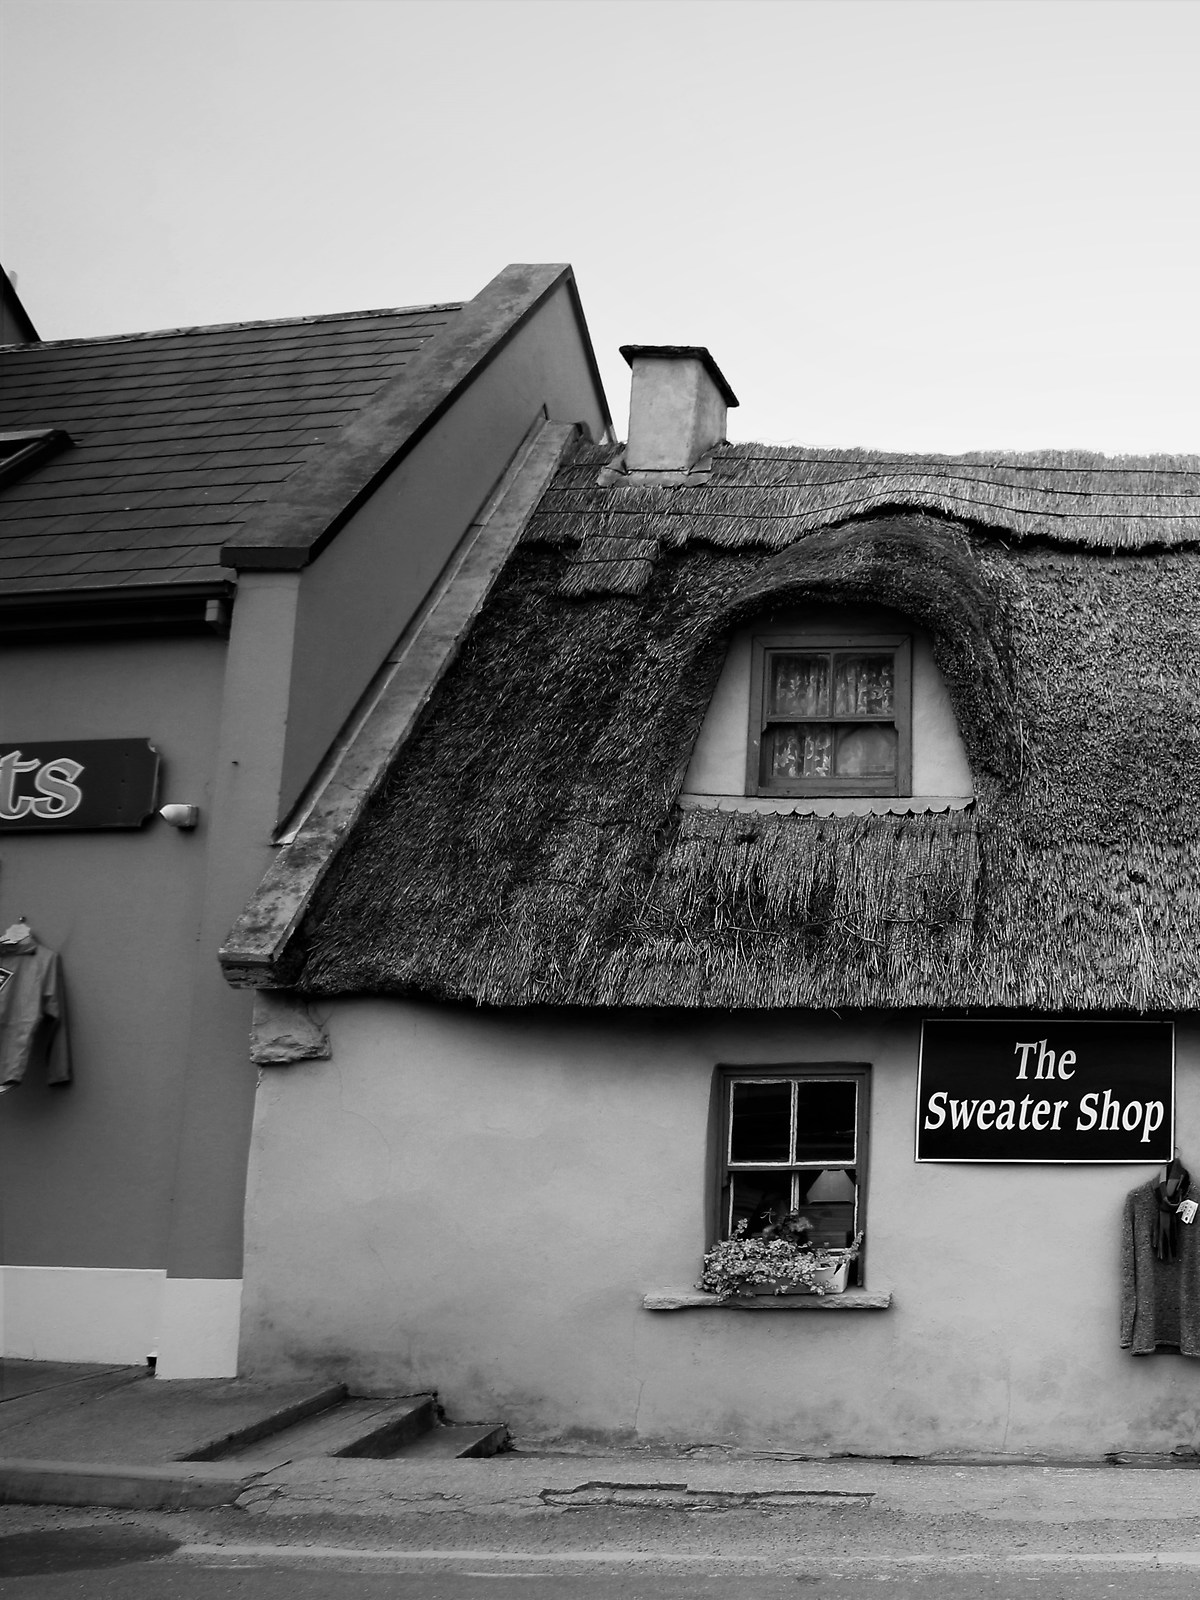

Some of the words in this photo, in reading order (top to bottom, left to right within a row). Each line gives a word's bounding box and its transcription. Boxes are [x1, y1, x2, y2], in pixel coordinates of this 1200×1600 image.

[1014, 1039, 1077, 1080] The
[924, 1091, 1069, 1130] Sweater
[1076, 1089, 1164, 1143] Shop
